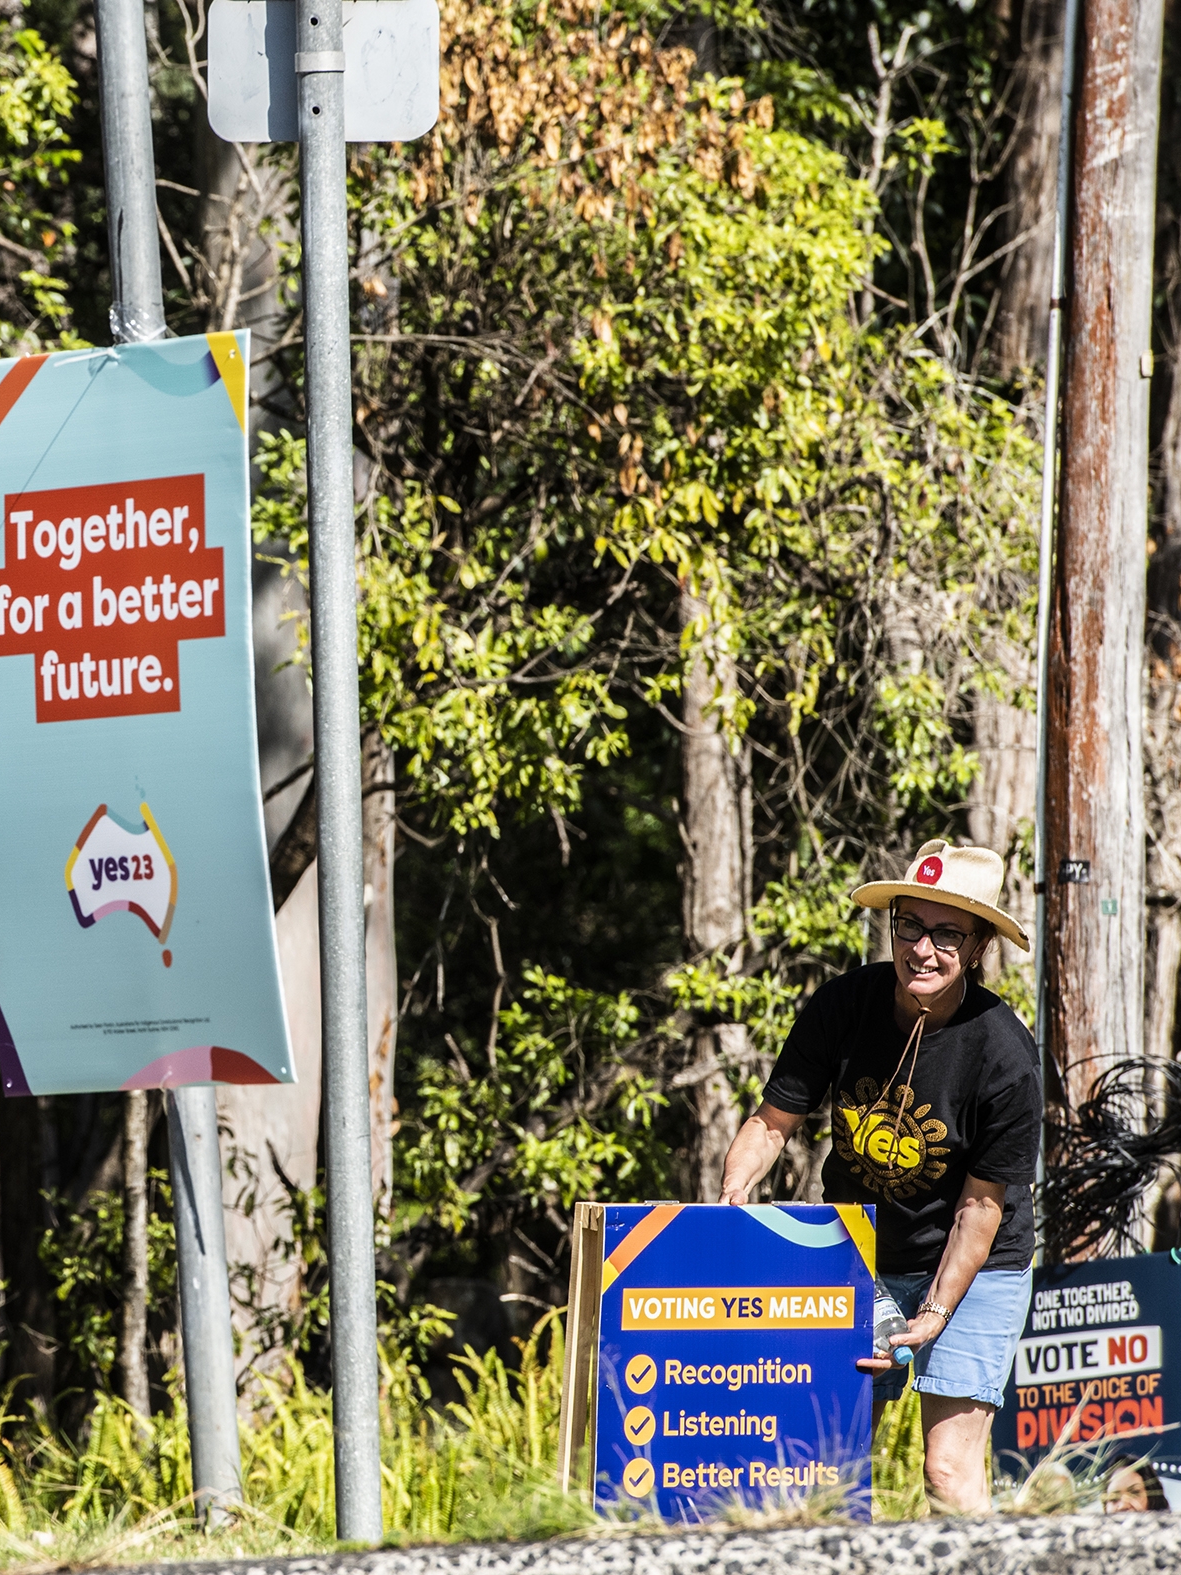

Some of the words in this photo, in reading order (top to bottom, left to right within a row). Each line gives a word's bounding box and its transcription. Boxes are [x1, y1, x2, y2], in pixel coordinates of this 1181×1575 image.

[10, 498, 199, 570] Together,
[57, 591, 82, 630] a
[93, 574, 219, 627] better
[41, 650, 173, 702] future.
[923, 865, 936, 877] Yes
[842, 1108, 920, 1169] Yes
[628, 1297, 716, 1320] VOTING
[721, 1297, 763, 1319] YES
[769, 1296, 848, 1319] MEANS
[1035, 1289, 1061, 1311] ONE
[1062, 1281, 1136, 1306] TOGETHER,
[1033, 1309, 1058, 1331] NOT
[1059, 1306, 1084, 1327] TWO
[1086, 1300, 1140, 1324] DIVIDED
[1025, 1338, 1099, 1375] VOTE
[1108, 1334, 1148, 1366] NO
[664, 1357, 812, 1391] Recognition
[1016, 1386, 1039, 1409] TO
[1042, 1383, 1077, 1405] THE
[1080, 1376, 1132, 1402] VOICE
[1136, 1373, 1162, 1395] OF
[663, 1409, 777, 1442] Listening
[663, 1463, 743, 1488] Better
[749, 1460, 840, 1487] Results
